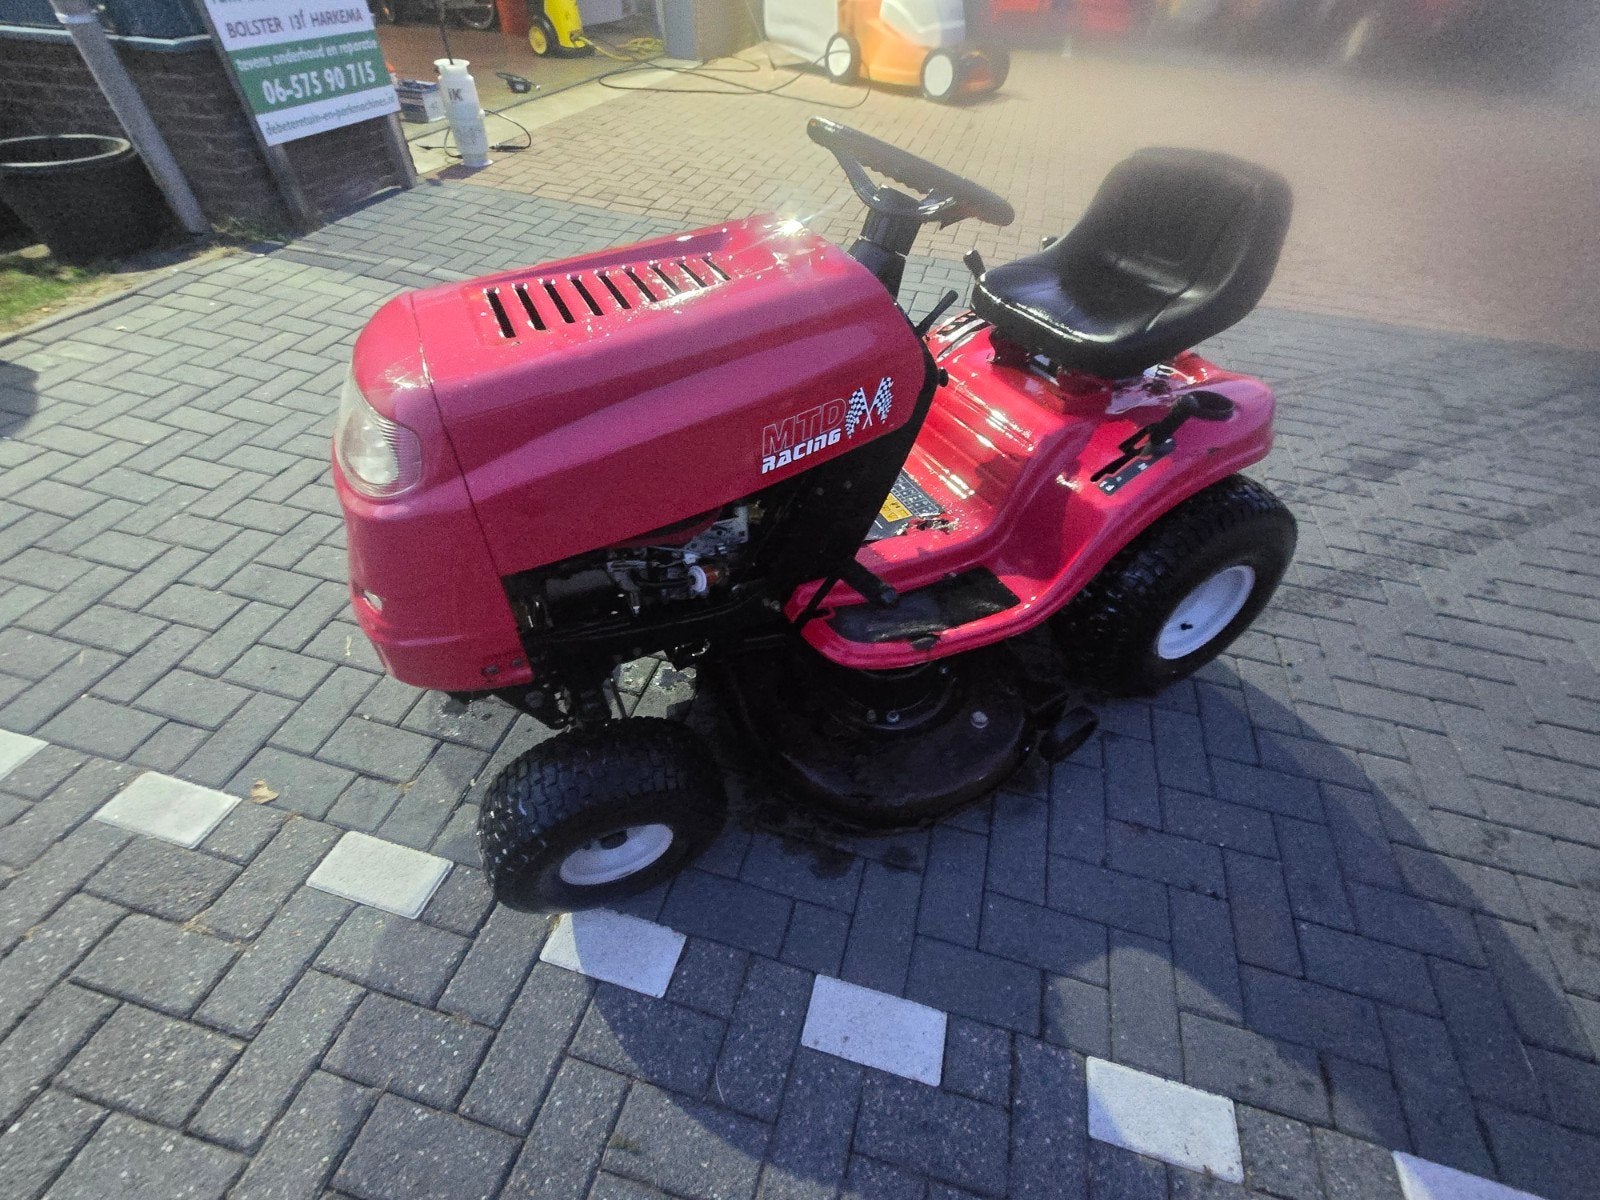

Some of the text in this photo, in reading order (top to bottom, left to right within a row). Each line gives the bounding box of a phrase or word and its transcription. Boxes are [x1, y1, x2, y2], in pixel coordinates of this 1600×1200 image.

[226, 17, 284, 38] BOLSTER
[310, 8, 363, 27] HARKEMA
[262, 60, 375, 104] 06-575 90 715
[762, 398, 847, 457] MTD
